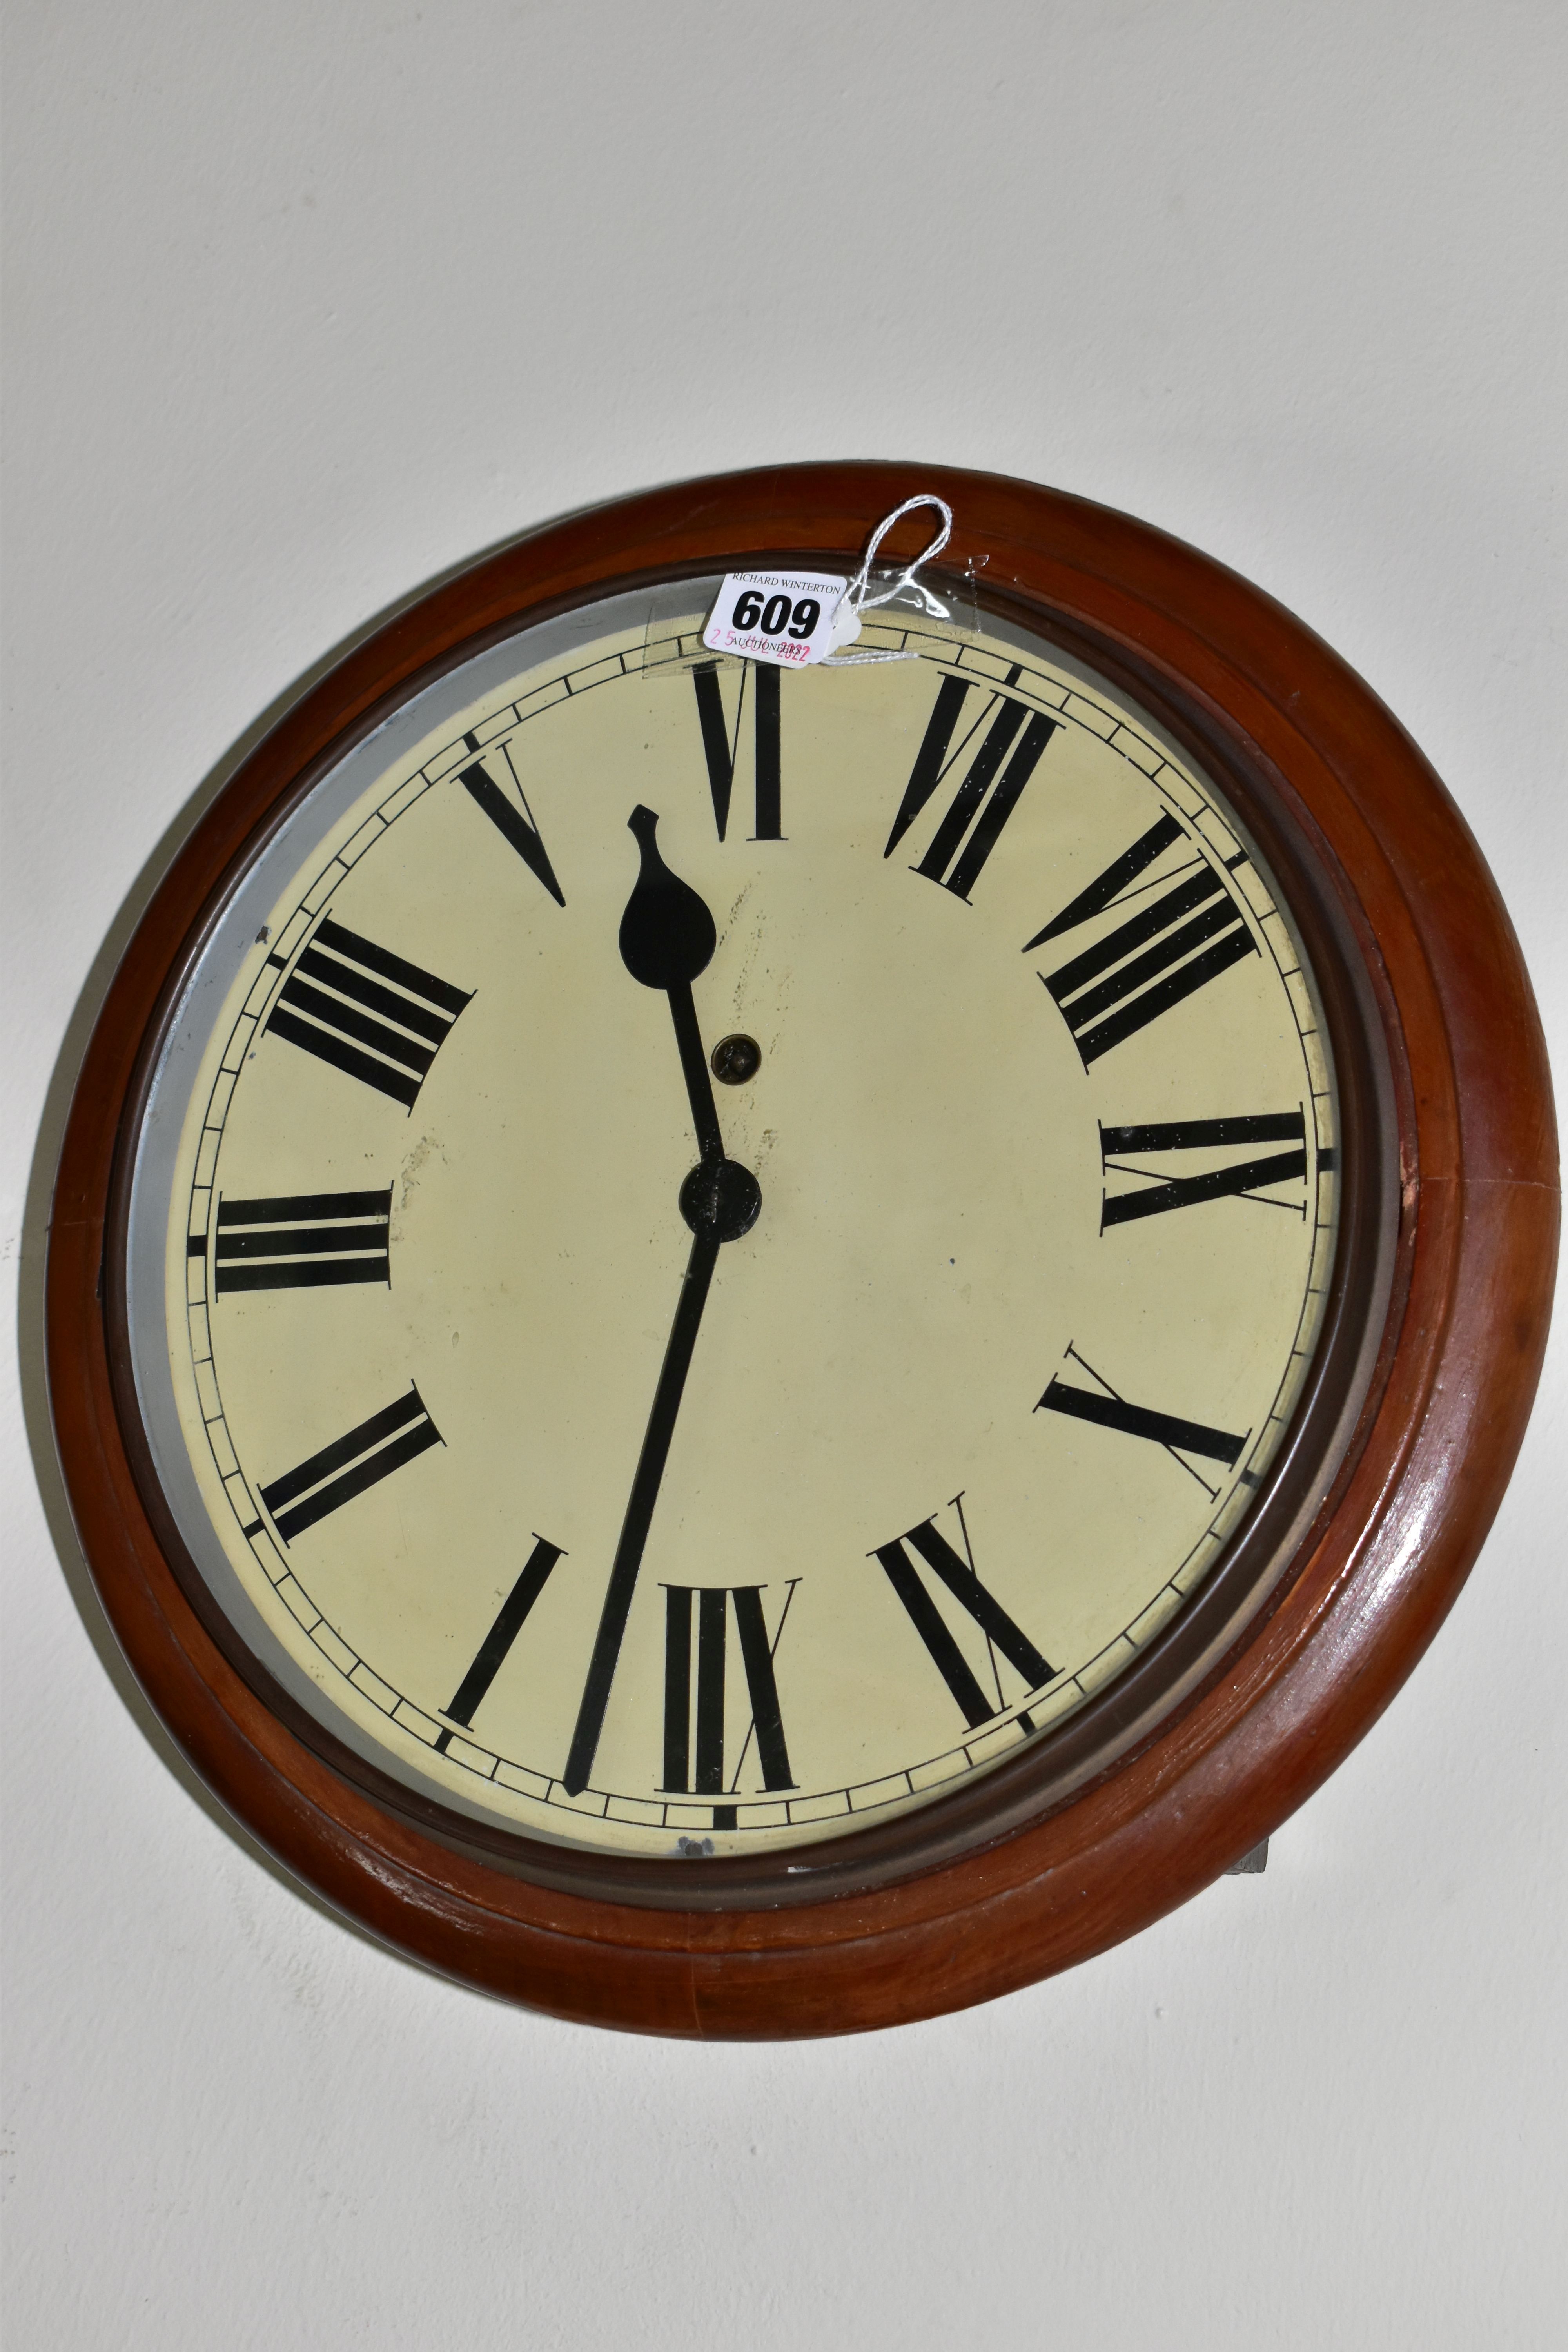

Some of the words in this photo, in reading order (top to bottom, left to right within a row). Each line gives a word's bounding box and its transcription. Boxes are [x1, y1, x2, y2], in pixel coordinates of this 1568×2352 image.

[730, 637, 801, 655] AUCTIONEERS
[732, 591, 820, 639] 609
[733, 572, 779, 586] RICHARD
[782, 579, 841, 594] WINTERTON
[777, 642, 810, 662] 2022
[449, 738, 566, 908] V
[884, 671, 1067, 906] VII
[261, 908, 478, 1118] IIII
[1022, 804, 1262, 1076] VIII
[214, 1179, 394, 1304] III
[256, 1378, 448, 1549] II
[1032, 1340, 1252, 1504] X
[437, 1532, 569, 1732] I
